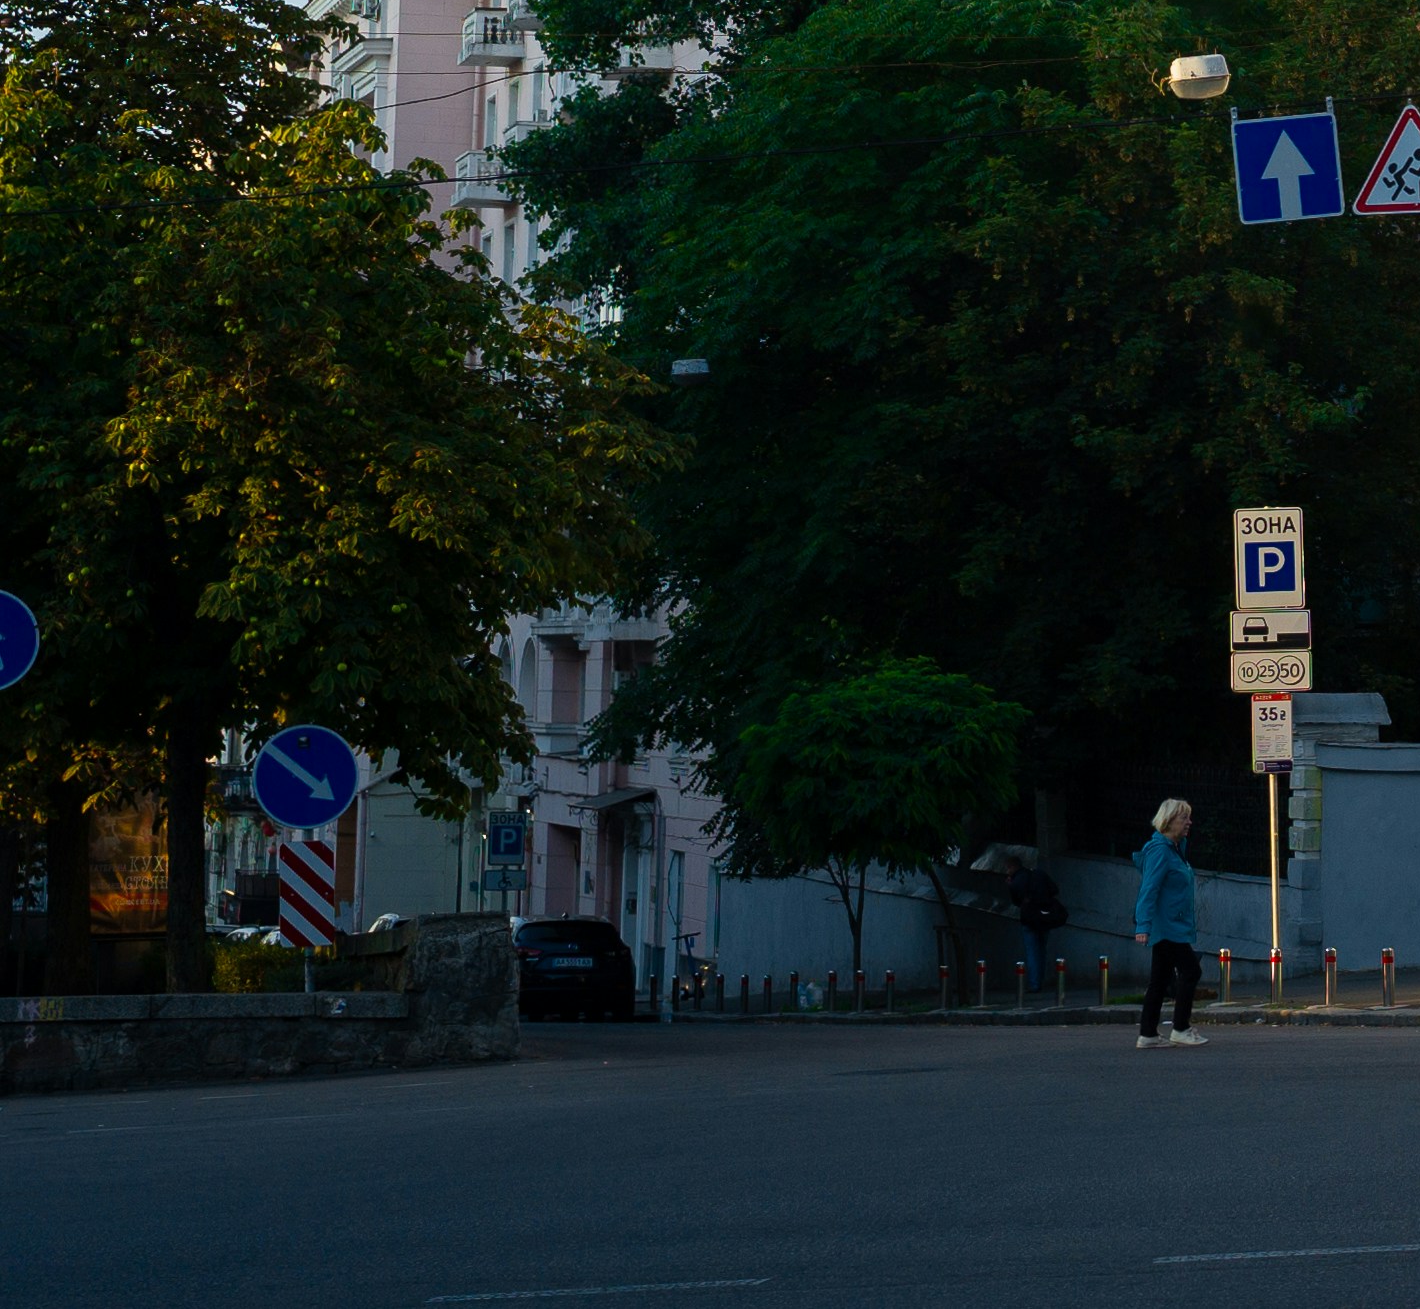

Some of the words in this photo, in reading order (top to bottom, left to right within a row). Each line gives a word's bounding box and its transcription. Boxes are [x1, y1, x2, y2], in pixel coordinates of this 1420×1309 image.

[1241, 516, 1297, 535] ЗОНА
[1257, 546, 1286, 588] P
[1241, 666, 1254, 678] 10
[1259, 665, 1276, 678] 25
[1280, 662, 1299, 679] 50
[491, 814, 525, 825] ЗОНА
[500, 828, 517, 853] P
